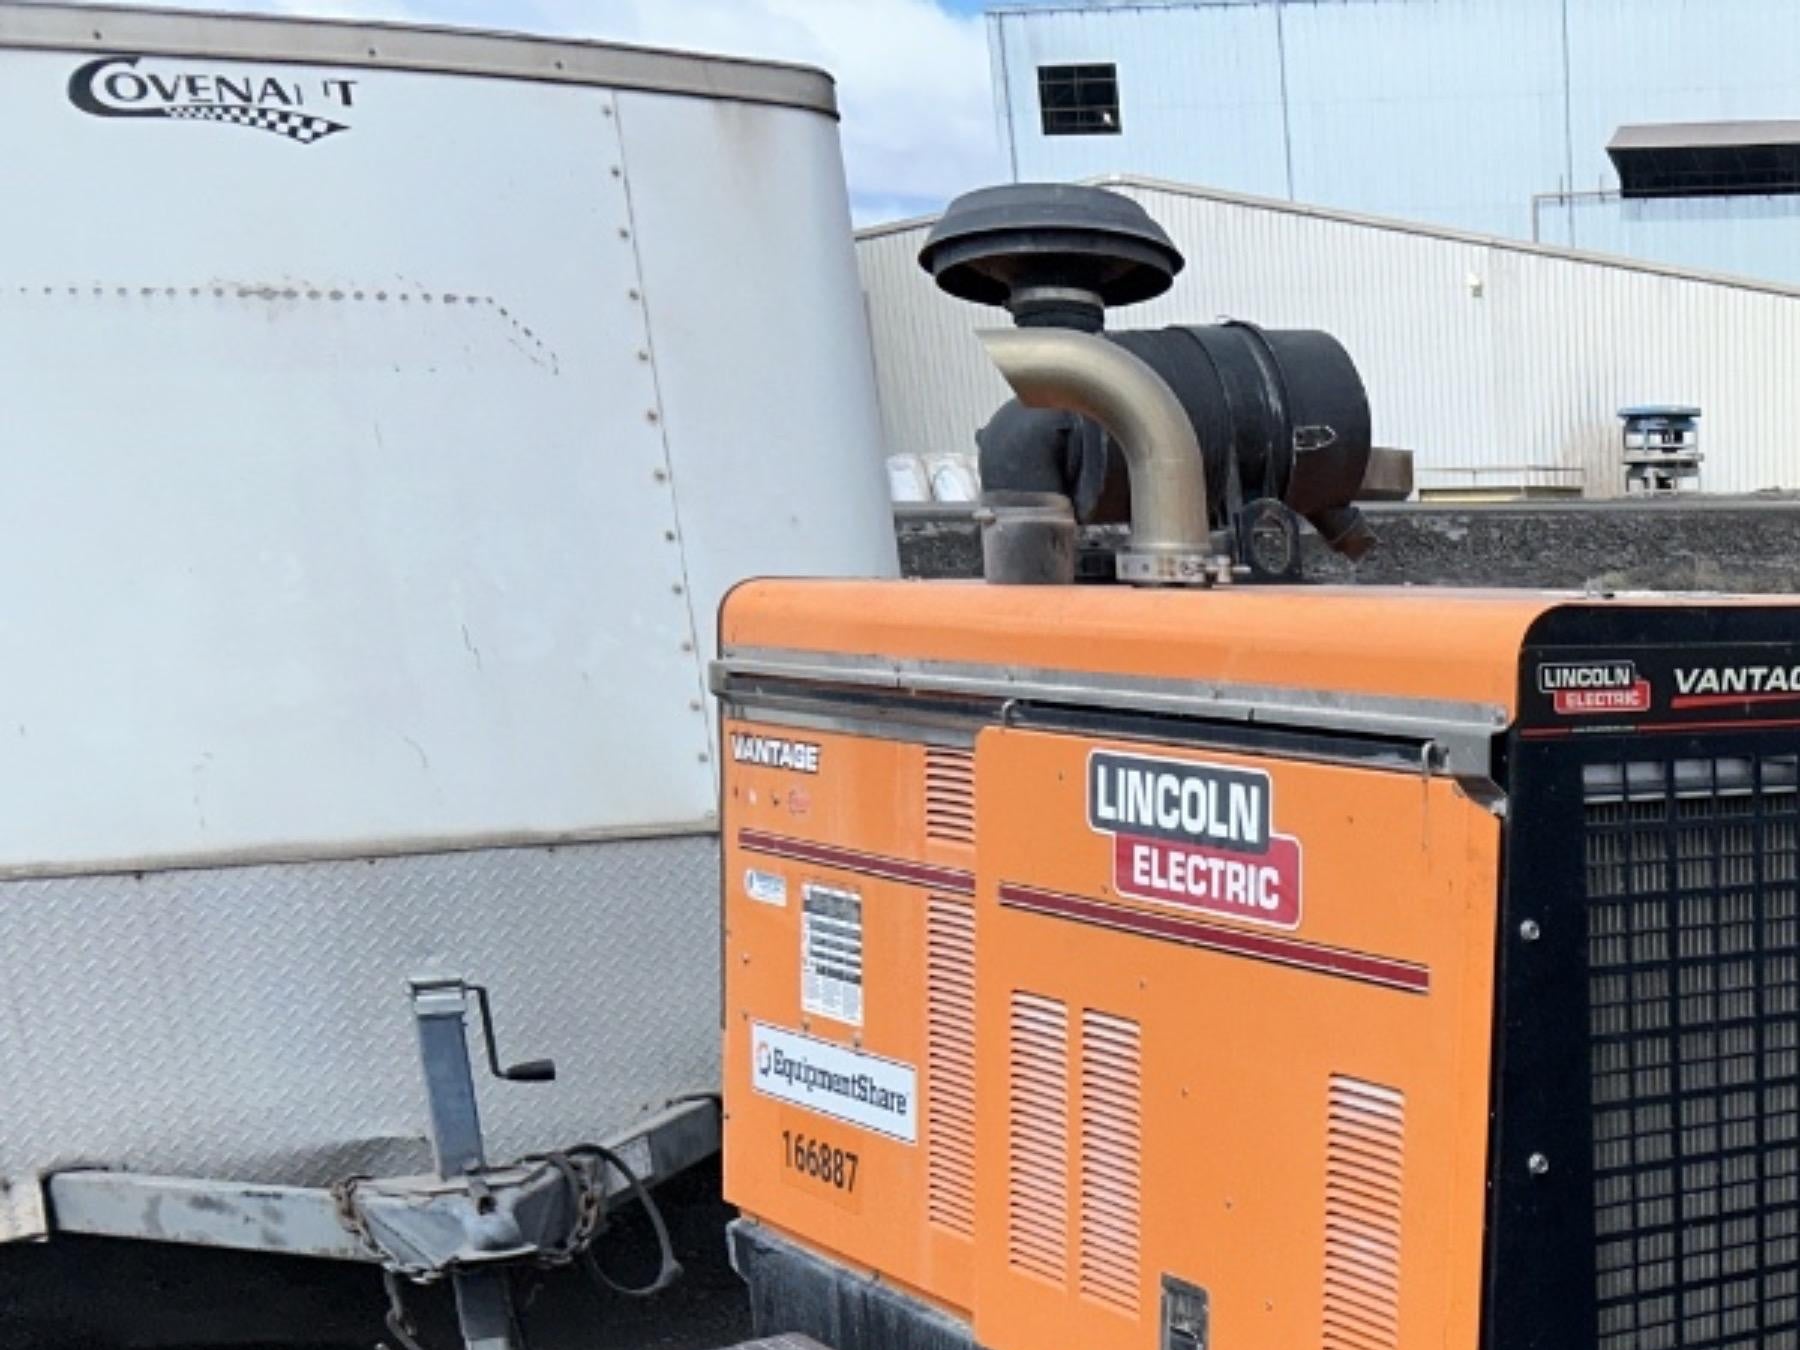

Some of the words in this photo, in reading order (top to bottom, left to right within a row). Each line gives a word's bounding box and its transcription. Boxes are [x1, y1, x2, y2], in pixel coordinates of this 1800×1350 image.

[1543, 667, 1631, 689] LINCOLN
[1565, 690, 1639, 707] ELECTRIC
[731, 733, 821, 775] VANTAGE
[1096, 764, 1261, 844] LINCOLN
[1133, 844, 1279, 911] ELECTRIC
[773, 1047, 908, 1116] EquipmentShare
[782, 1130, 859, 1193] 166887
